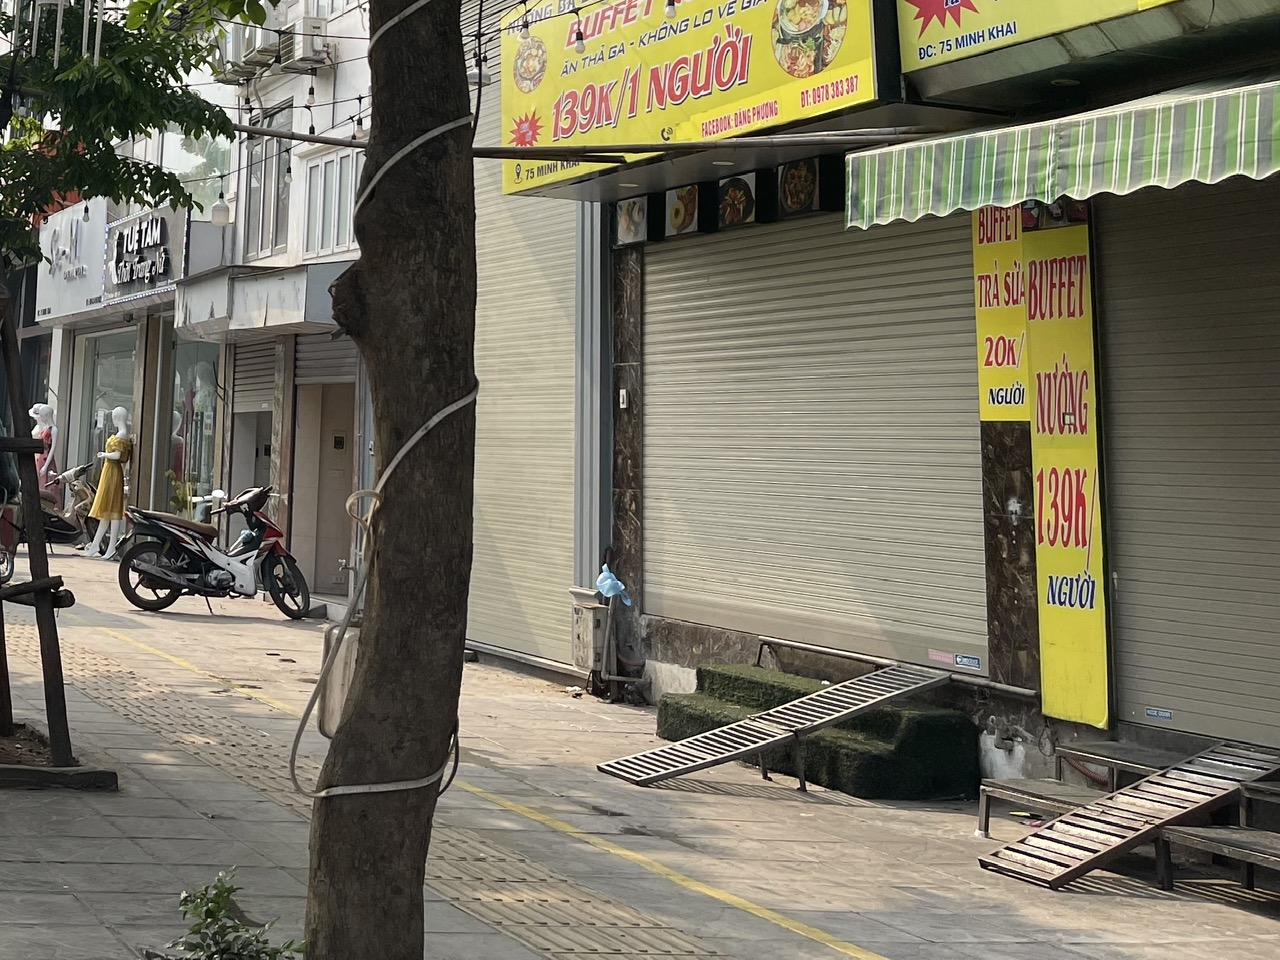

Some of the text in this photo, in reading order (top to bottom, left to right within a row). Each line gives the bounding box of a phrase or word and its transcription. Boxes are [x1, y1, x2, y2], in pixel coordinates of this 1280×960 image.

[560, 58, 579, 77] ĂN
[581, 44, 605, 68] THẢ
[608, 44, 625, 60] GA
[638, 20, 690, 48] KHÔNG
[693, 8, 713, 28] LO
[918, 21, 1017, 60] ĐC: 75 MINH KHAI
[646, 23, 753, 114] NGƯỜI
[801, 75, 858, 108] ĐT: 0978 383 387
[702, 114, 733, 138] FACEBOOK:
[525, 168, 535, 180] 75
[537, 161, 558, 177] MINH
[978, 205, 1020, 245] BUFFET
[977, 260, 1000, 308] TRÀ
[1028, 254, 1087, 321] BUFFET
[988, 381, 1025, 406] NGƯỜI
[1047, 569, 1096, 609] NGƯỜI
